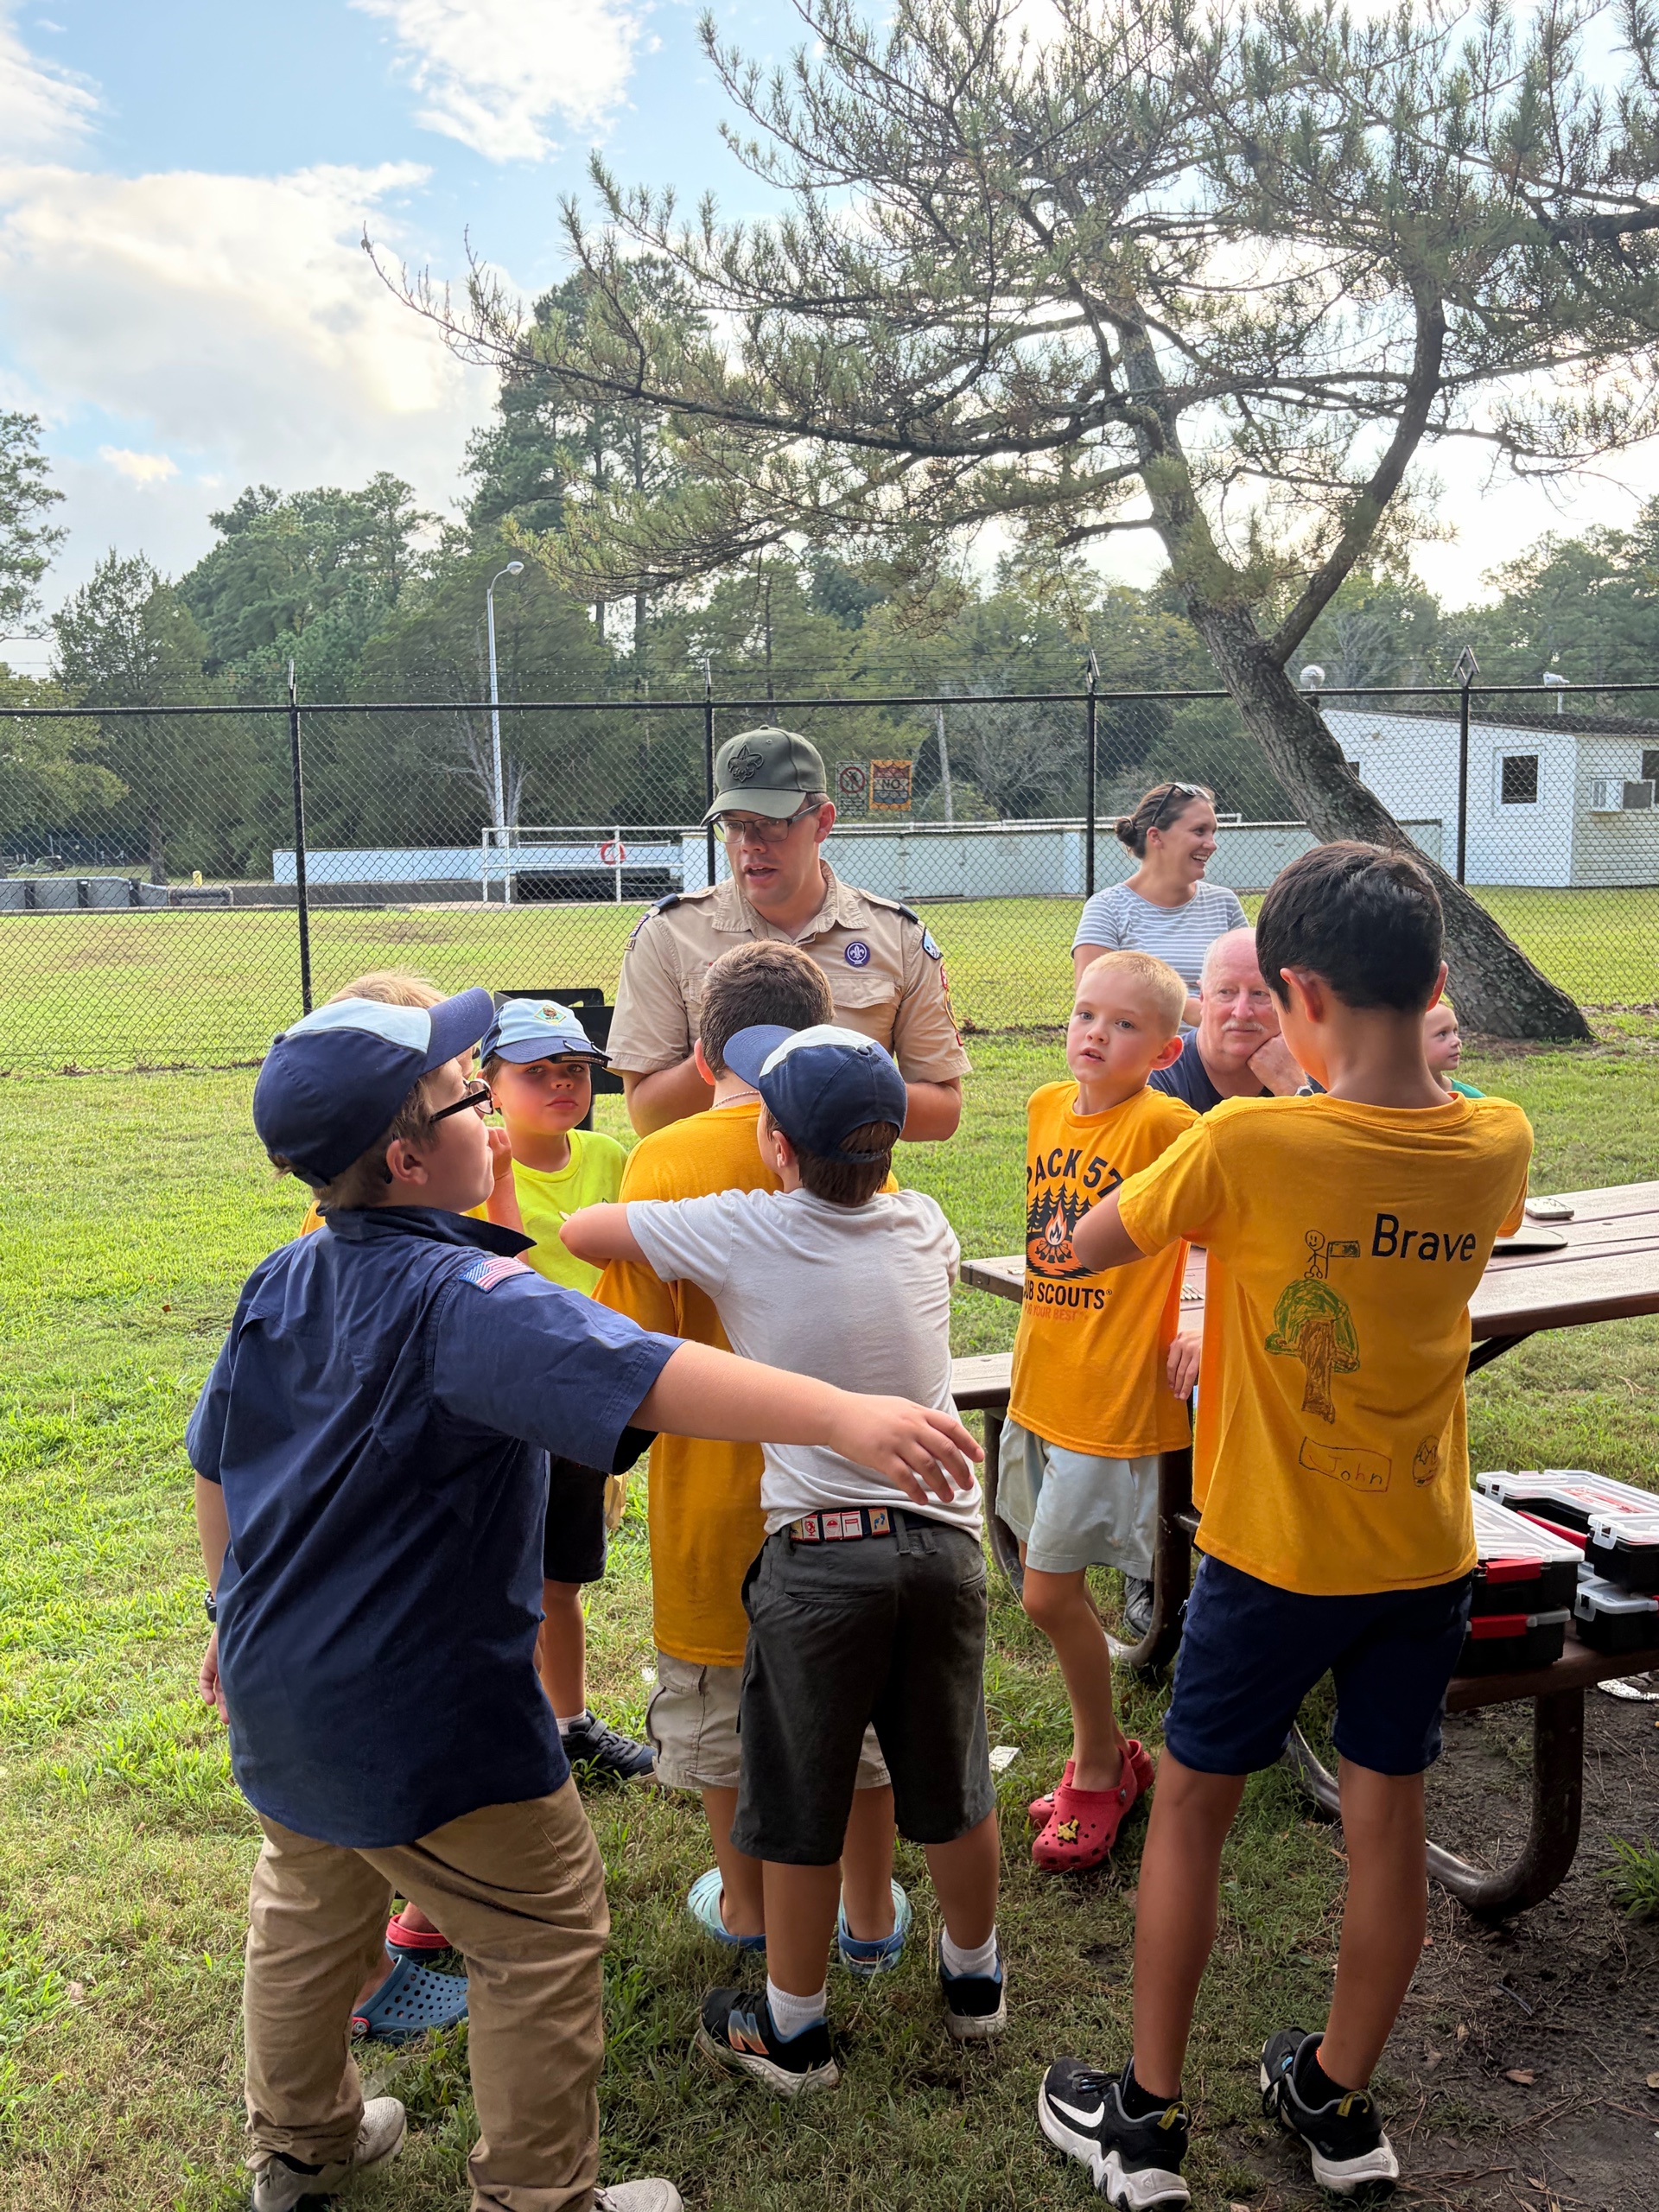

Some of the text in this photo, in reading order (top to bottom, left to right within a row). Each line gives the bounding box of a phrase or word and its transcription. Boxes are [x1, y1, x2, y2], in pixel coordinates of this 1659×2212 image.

[1083, 1156, 1124, 1198] 57
[1371, 1212, 1477, 1262] Brave
[1037, 1281, 1105, 1310] SCOUTS
[1033, 1304, 1052, 1319] YOUR
[1309, 1454, 1382, 1484] John
